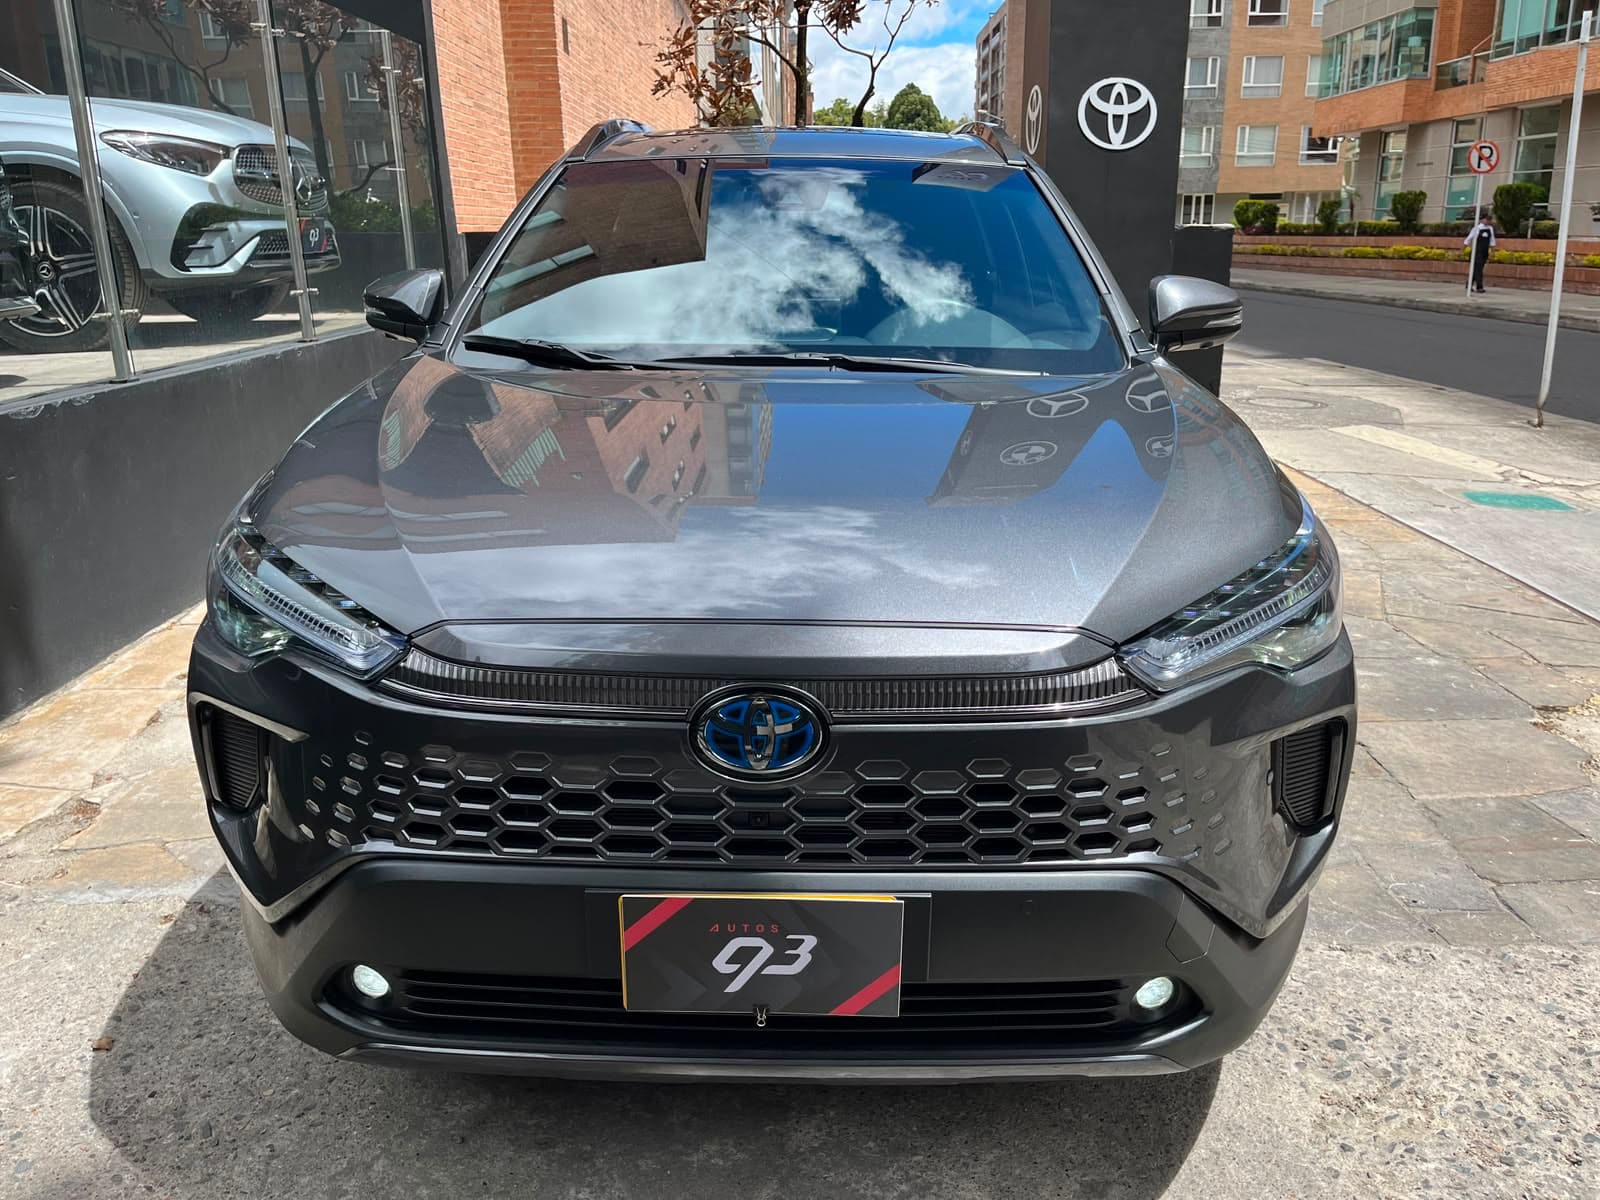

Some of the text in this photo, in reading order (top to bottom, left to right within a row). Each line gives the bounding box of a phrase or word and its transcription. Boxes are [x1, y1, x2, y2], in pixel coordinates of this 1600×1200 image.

[1477, 145, 1494, 169] P
[709, 923, 779, 933] AUTOS
[712, 934, 818, 993] 93
